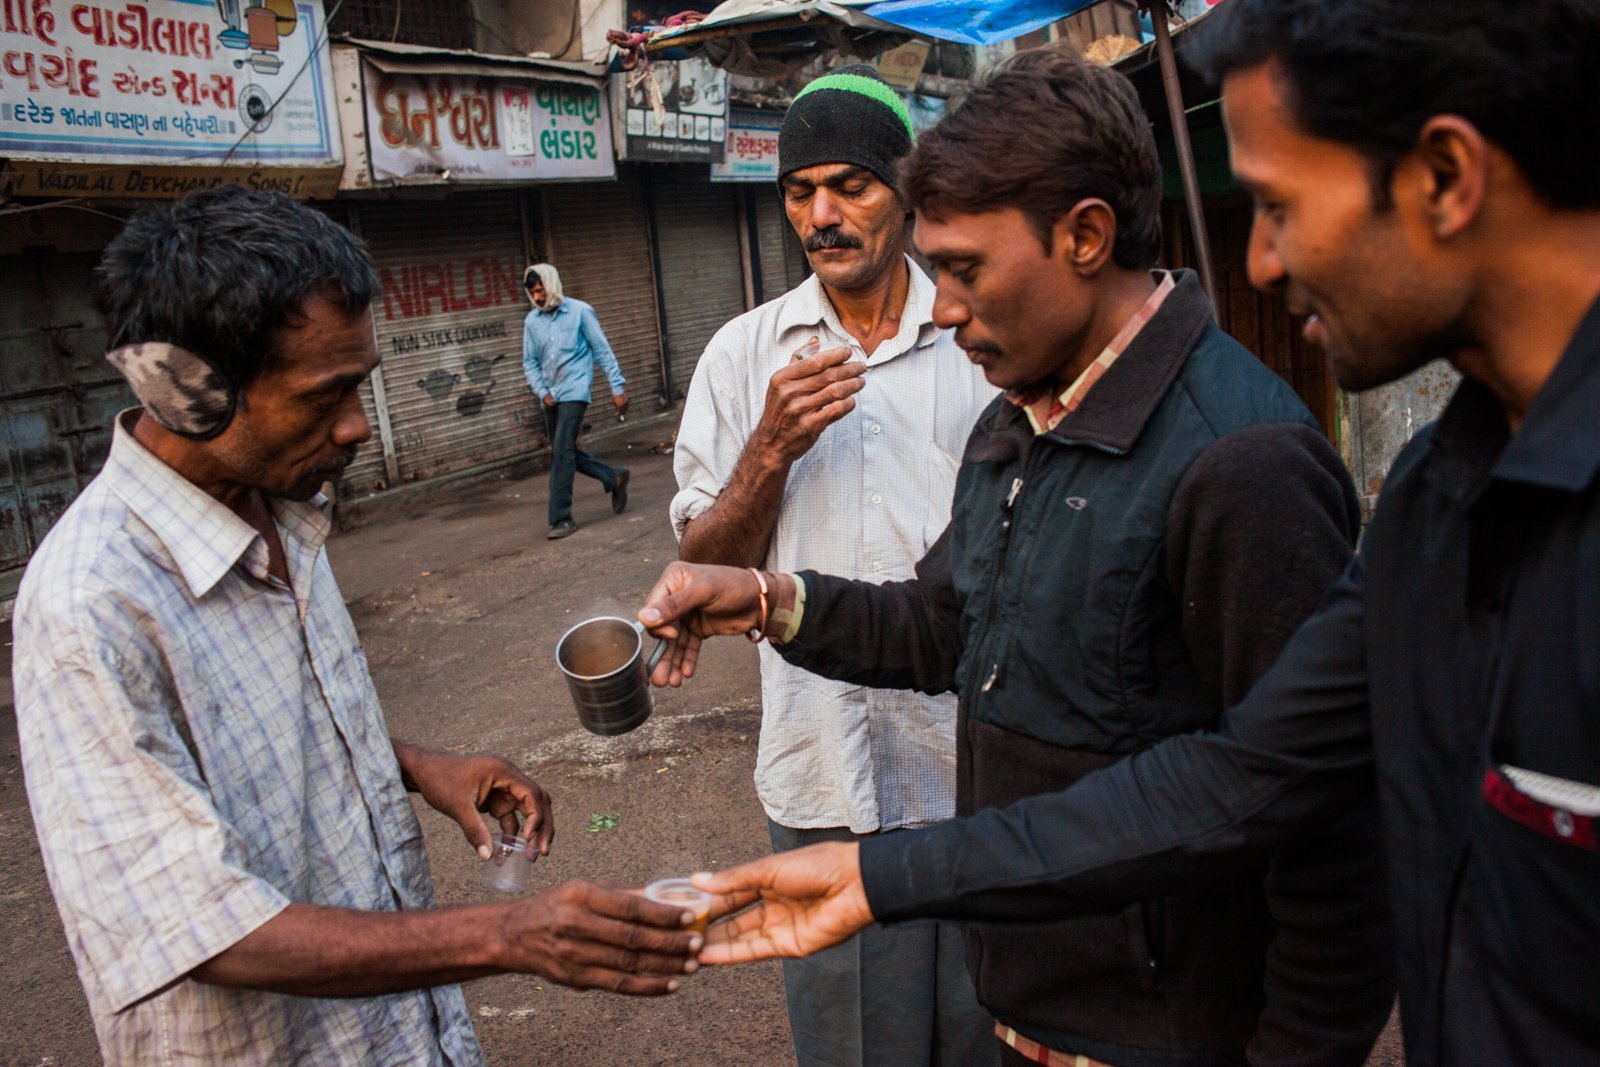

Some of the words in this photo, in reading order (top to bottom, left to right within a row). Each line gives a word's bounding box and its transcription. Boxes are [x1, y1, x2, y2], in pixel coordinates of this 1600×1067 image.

[70, 0, 214, 60] વાડીલાલ
[14, 97, 55, 124] દરેક
[60, 107, 102, 127] જાતના
[105, 111, 149, 136] વાસણ
[152, 115, 167, 131] ના
[536, 85, 601, 126] વાસણ
[540, 118, 598, 160] ભંડાર
[38, 168, 115, 191] VADILAL
[379, 255, 520, 321] NIRLON
[392, 334, 420, 354] NON
[423, 327, 453, 348] STICK
